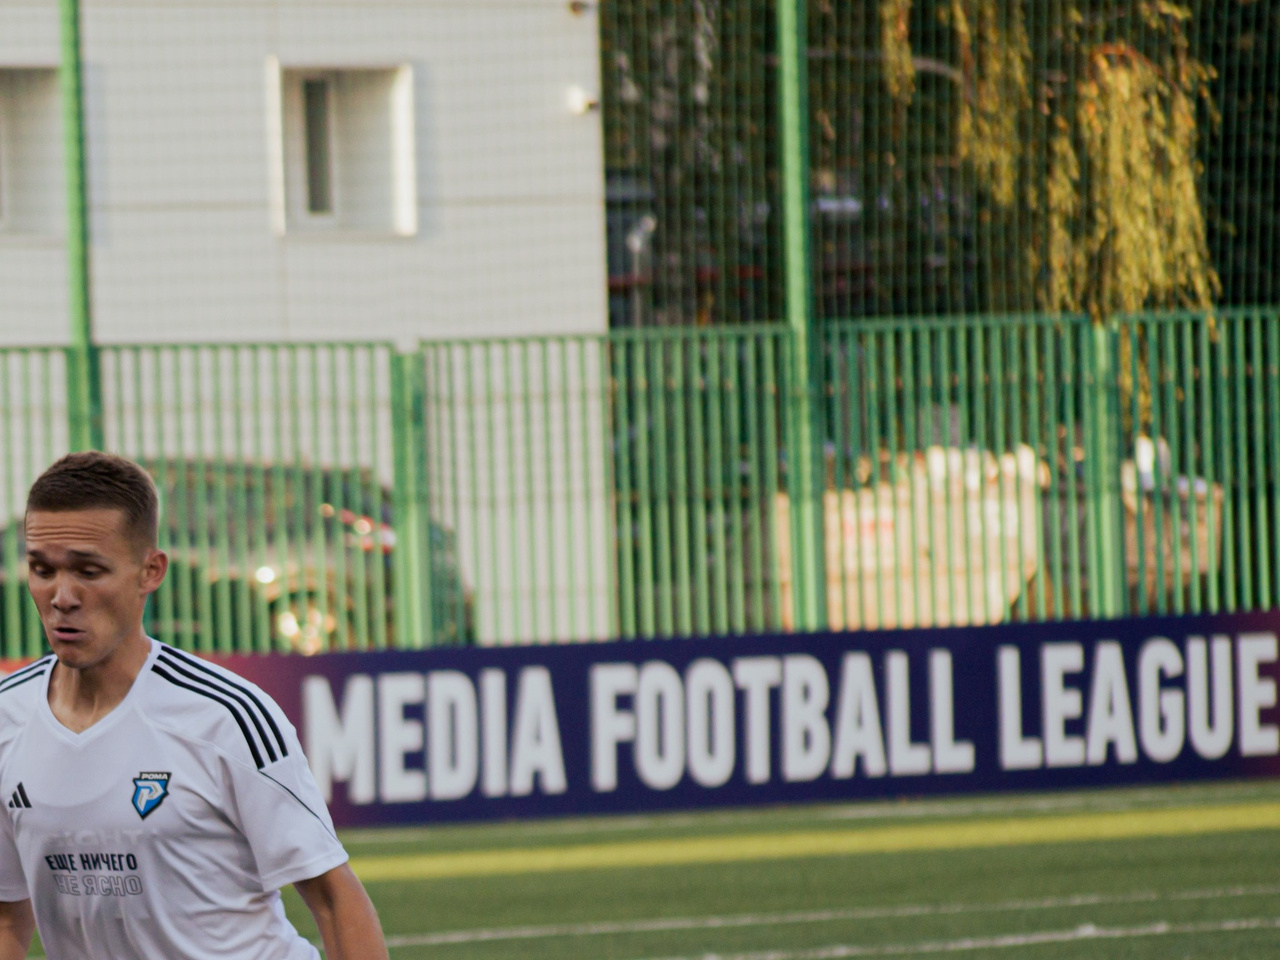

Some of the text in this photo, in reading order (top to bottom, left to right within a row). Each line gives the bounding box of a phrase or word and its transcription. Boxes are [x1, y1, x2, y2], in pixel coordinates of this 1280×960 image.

[303, 632, 1280, 804] MEDIA FOOTBALL LEAGUE
[44, 853, 138, 874] ЕЩЕ НИЧЕГО
[53, 874, 143, 897] НЕ ЯСНО
